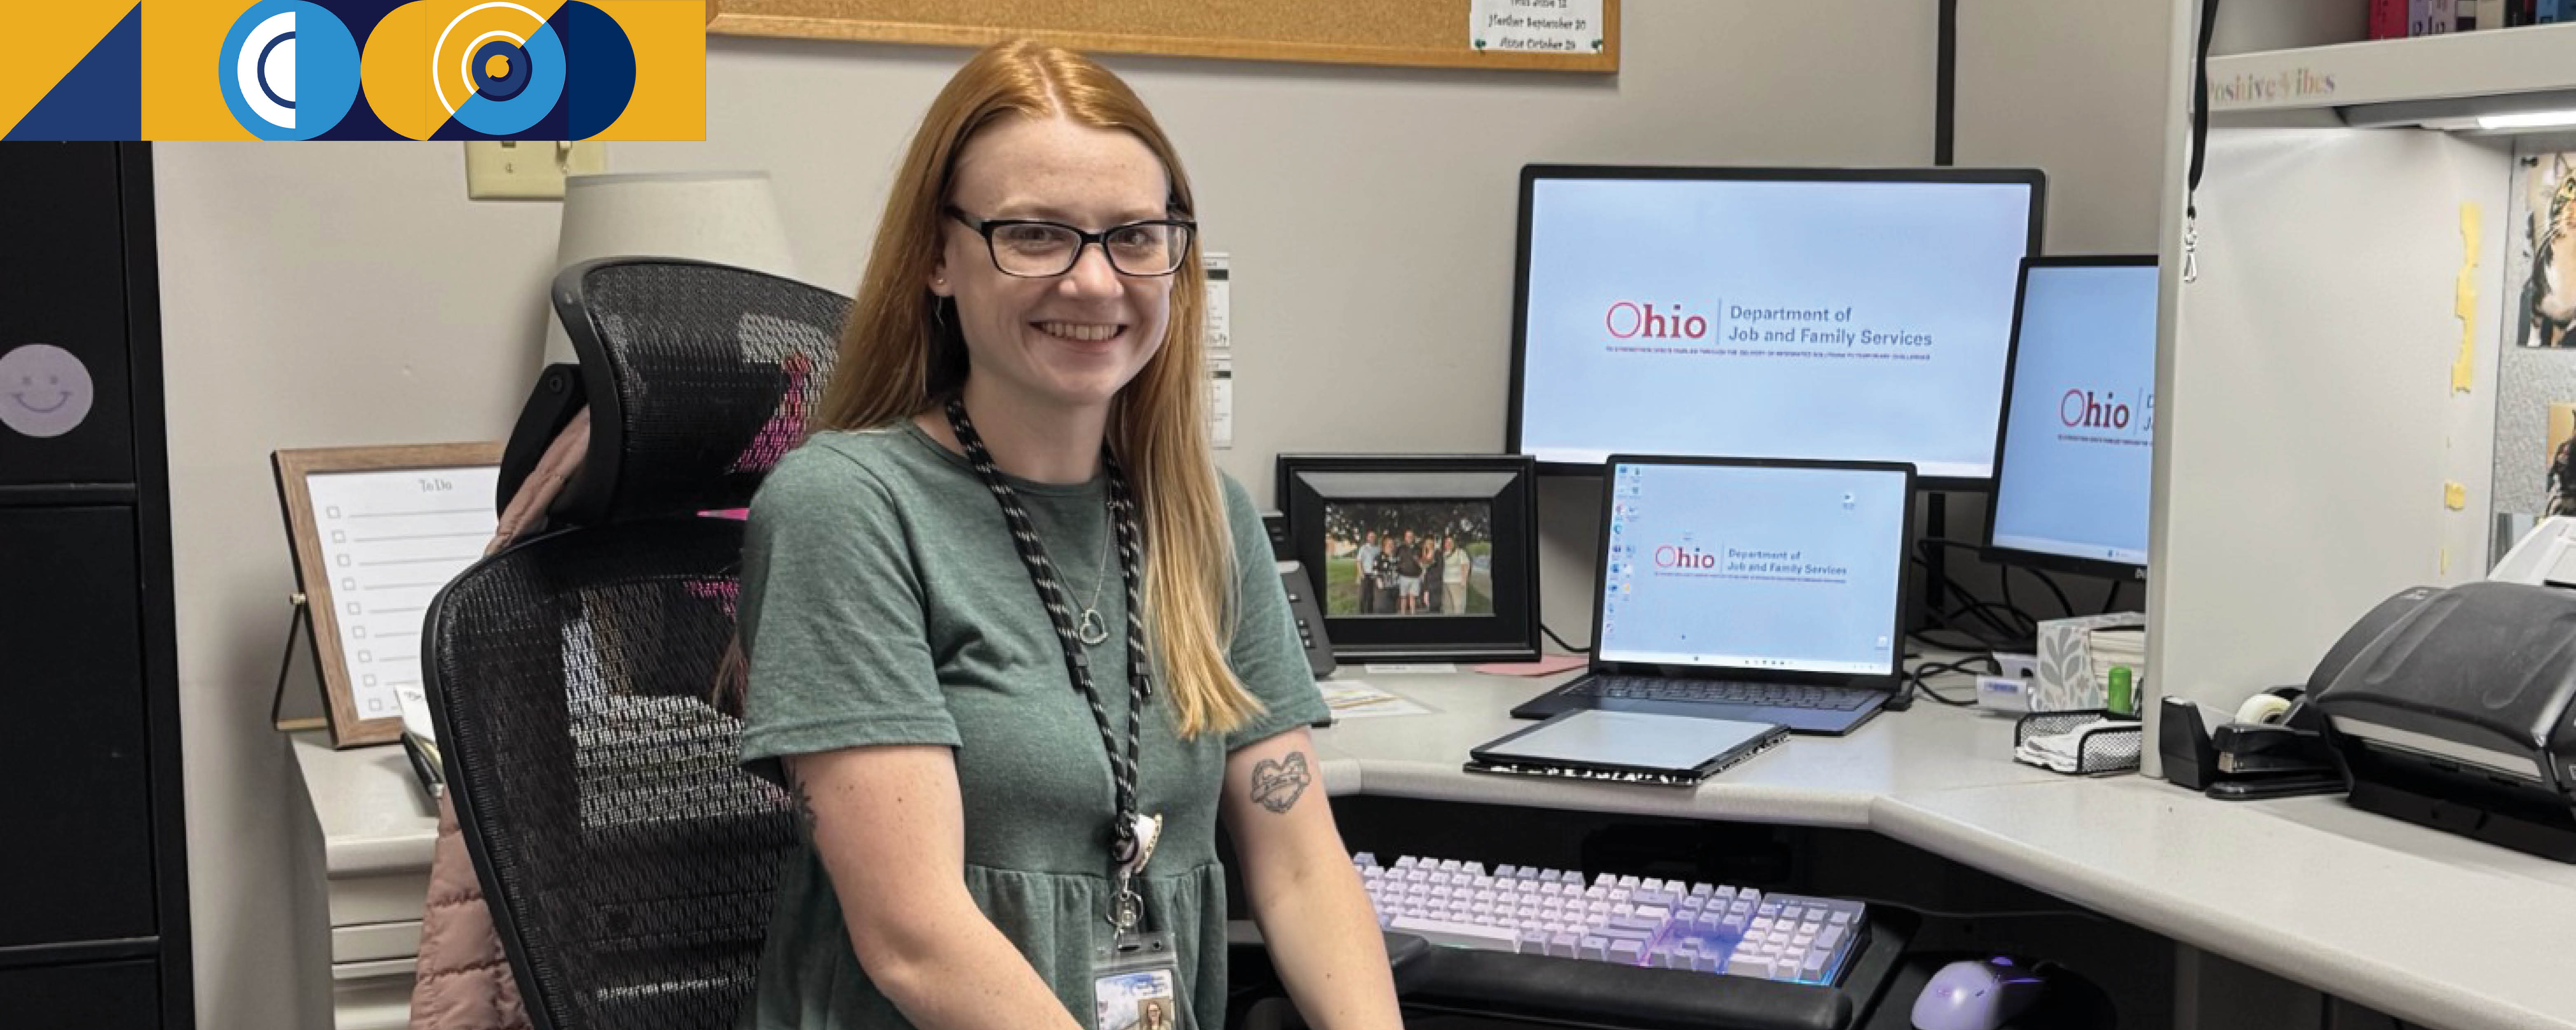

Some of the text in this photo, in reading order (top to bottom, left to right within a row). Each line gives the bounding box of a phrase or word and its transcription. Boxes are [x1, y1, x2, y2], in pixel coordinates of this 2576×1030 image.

[1527, 16, 1573, 30] September
[1527, 37, 1563, 49] October
[1606, 301, 1708, 339] Ohio
[1731, 305, 1852, 323] Department of
[1728, 326, 1932, 347] Job and Family Services
[2061, 389, 2130, 429] Ohio
[1655, 544, 1715, 569] Ohio
[1729, 548, 1800, 560] Department of
[1727, 562, 1848, 575] Job and Family Services
